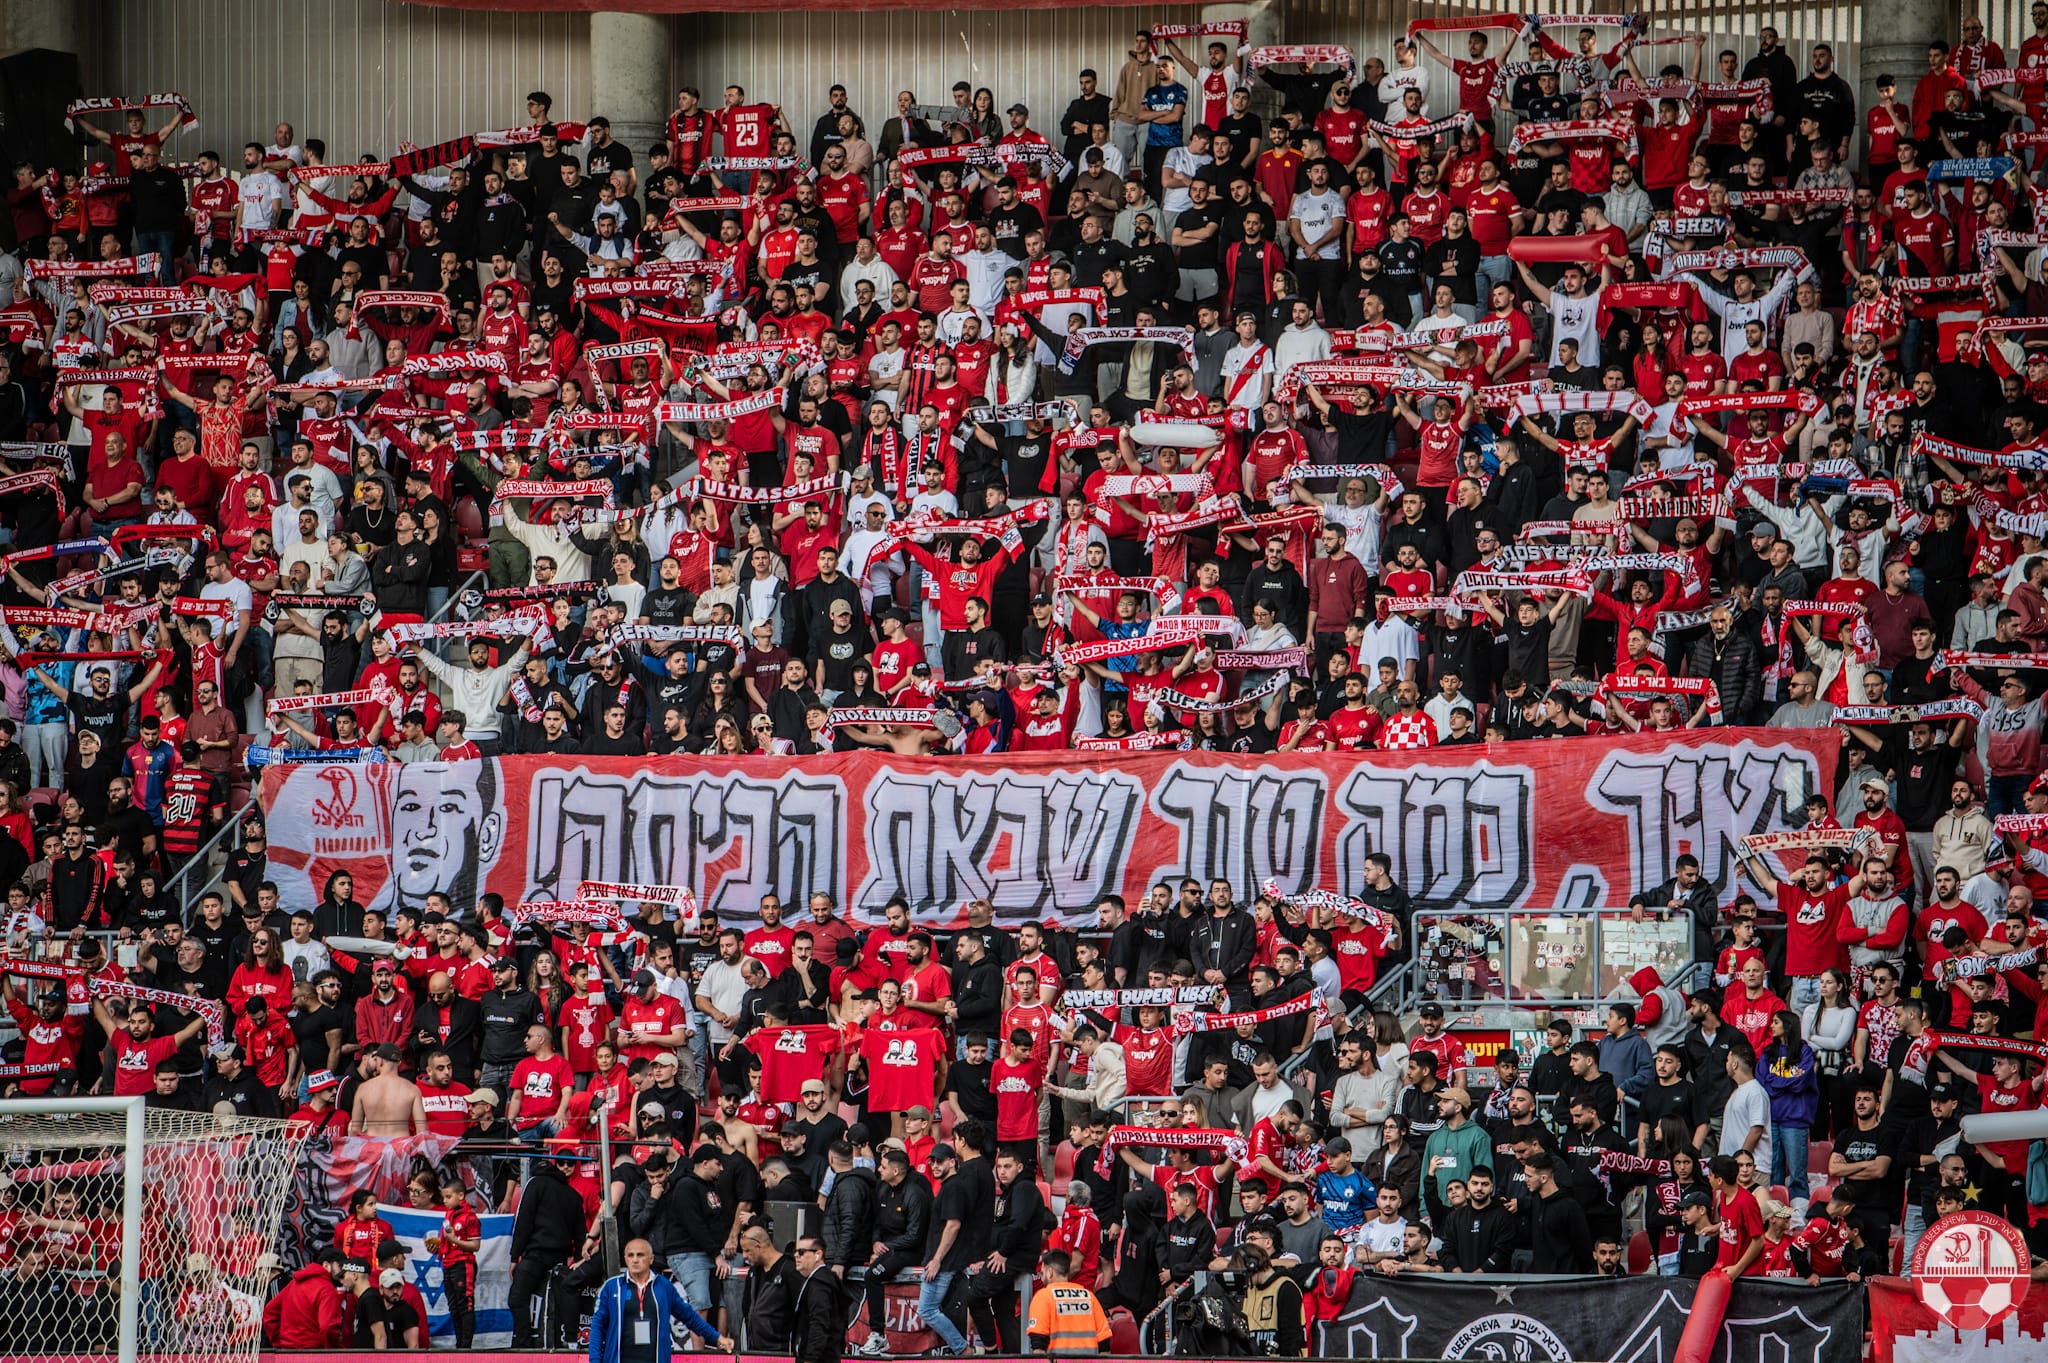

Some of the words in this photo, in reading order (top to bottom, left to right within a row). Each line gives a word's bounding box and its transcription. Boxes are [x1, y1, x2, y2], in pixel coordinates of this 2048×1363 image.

[734, 122, 759, 147] 23
[900, 150, 928, 164] HAPOEL
[931, 147, 950, 159] BEER
[717, 196, 741, 205] הפועל
[1742, 191, 1774, 201] שבע
[1780, 190, 1807, 201] באר
[1810, 188, 1846, 201] הפועל
[679, 199, 696, 208] שבע
[698, 198, 715, 207] באר
[1675, 217, 1726, 234] SHEV
[34, 259, 74, 270] שבע
[91, 257, 132, 268] באר
[120, 290, 143, 300] באר
[144, 288, 168, 299] BEER
[588, 283, 613, 296] הפועל
[633, 280, 651, 291] באר
[360, 294, 380, 305] שבע
[384, 293, 402, 303] באר
[405, 292, 434, 302] הפועל
[1021, 292, 1049, 304] HAPOEL
[1054, 290, 1071, 300] BEER
[1078, 288, 1101, 300] SHEVA
[110, 301, 209, 318] באר-שבע
[1988, 318, 2012, 327] שבע
[2015, 317, 2037, 326] באר
[165, 356, 189, 364] שבע
[191, 355, 213, 363] באר
[214, 354, 248, 362] הפועל
[911, 362, 936, 372] OPEL
[1308, 372, 1330, 381] שבע
[1330, 372, 1353, 381] באר
[1353, 371, 1373, 381] BEER
[343, 377, 383, 389] הפועל
[1685, 400, 1710, 411] שבע
[1750, 393, 1787, 405] הפועל
[562, 413, 648, 426] MELIKSON
[455, 436, 475, 448] שבע
[479, 433, 501, 445] באר
[1070, 430, 1098, 448] HBS
[1960, 447, 1992, 465] תשארו
[1994, 452, 2024, 468] תמיד
[11, 477, 28, 488] באר
[28, 472, 54, 484] הפועל
[1628, 498, 1706, 516] CHAMPIONS
[1464, 571, 1504, 588] הפועל
[1506, 571, 1533, 586] באר
[1535, 571, 1568, 586] שבע
[584, 581, 596, 592] FC
[5, 608, 29, 617] שבע
[32, 610, 53, 618] באר
[55, 612, 87, 621] הפועל
[45, 617, 78, 625] גאוות
[1157, 619, 1180, 630] MAOR
[1182, 619, 1220, 631] MELIKSON
[1218, 653, 1254, 667] בגללה
[1978, 659, 1997, 667] BEER
[1999, 659, 2024, 667] SHEVA
[1615, 676, 1639, 689] שבע
[1671, 676, 1703, 690] הפועל
[337, 688, 372, 702] הפועל
[1127, 735, 1167, 748] אלופת
[167, 794, 196, 823] 24
[1158, 768, 1324, 912] טוב
[1342, 768, 1530, 912] כמה
[1749, 834, 1778, 848] שבע
[1783, 831, 1811, 845] באר
[1815, 829, 1855, 842] הפועל
[528, 774, 844, 928] הביתה!
[858, 774, 1136, 922] שבאת
[583, 883, 610, 898] שבע
[615, 885, 637, 899] באר
[643, 885, 678, 902] הפועל
[4, 960, 15, 970] FC
[18, 963, 63, 977] BEER-SHEVA
[1957, 955, 1984, 976] ON
[1063, 990, 1114, 1007] SUPER
[1118, 988, 1173, 1005] DUPER
[1176, 985, 1214, 1003] HBS!
[1266, 999, 1309, 1018] אלופת
[1210, 1010, 1258, 1029] המדינה
[1940, 1033, 1974, 1045] HAPOEL
[1976, 1037, 2034, 1054] BEER-SHEVA
[2036, 1046, 2048, 1057] FC
[25, 1062, 61, 1075] HAPOEL
[1113, 1130, 1151, 1144] HAPOEL
[1156, 1131, 1224, 1146] BEER-SHEVA
[1057, 1302, 1090, 1315] סדרן
[1453, 1318, 1501, 1356] BEER-SHEVA
